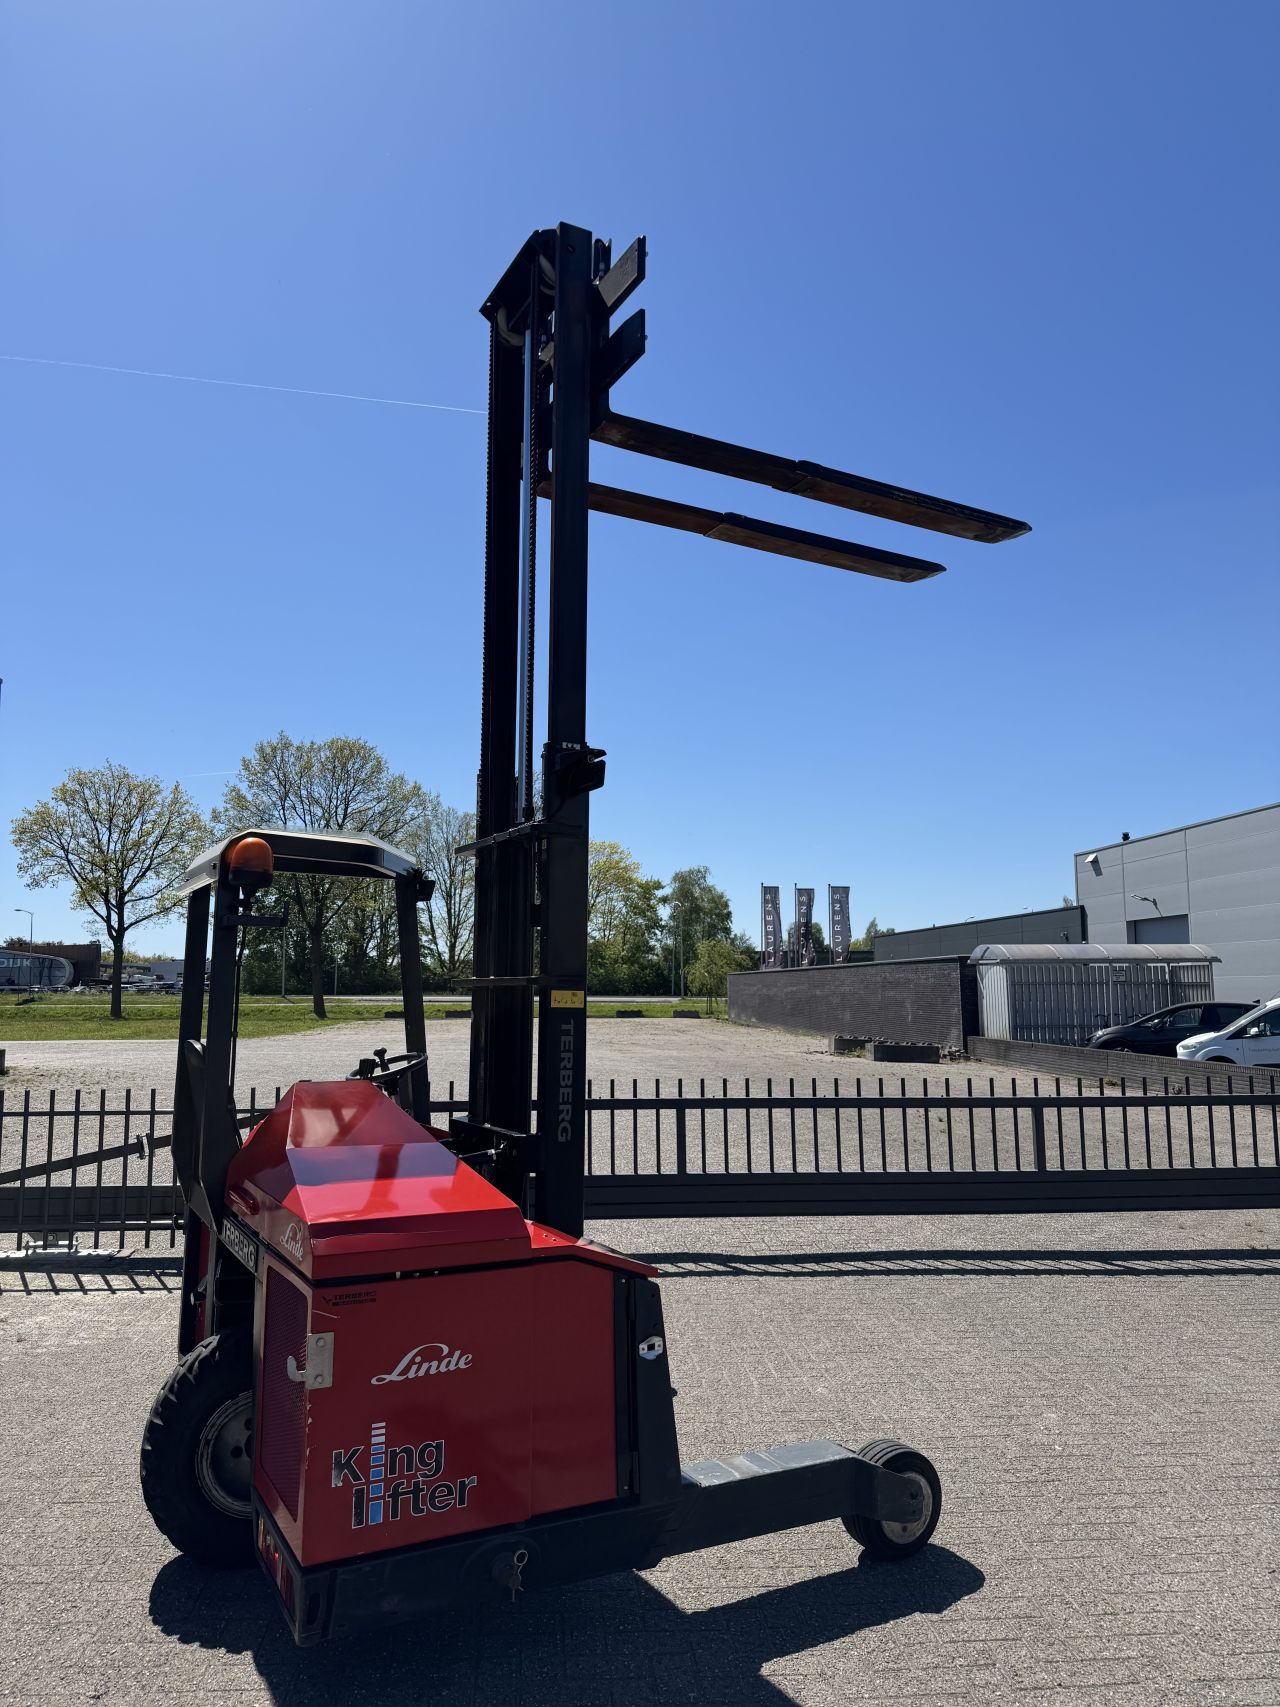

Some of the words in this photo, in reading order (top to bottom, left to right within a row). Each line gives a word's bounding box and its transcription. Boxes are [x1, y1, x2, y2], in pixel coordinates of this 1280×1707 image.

[765, 894, 774, 962] LAURENS
[834, 894, 843, 962] LAURENS
[558, 1019, 574, 1143] TERBERG
[223, 1219, 256, 1267] TERBERG
[280, 1223, 303, 1261] Linde
[370, 1343, 473, 1385] Linde
[331, 1422, 445, 1488] King
